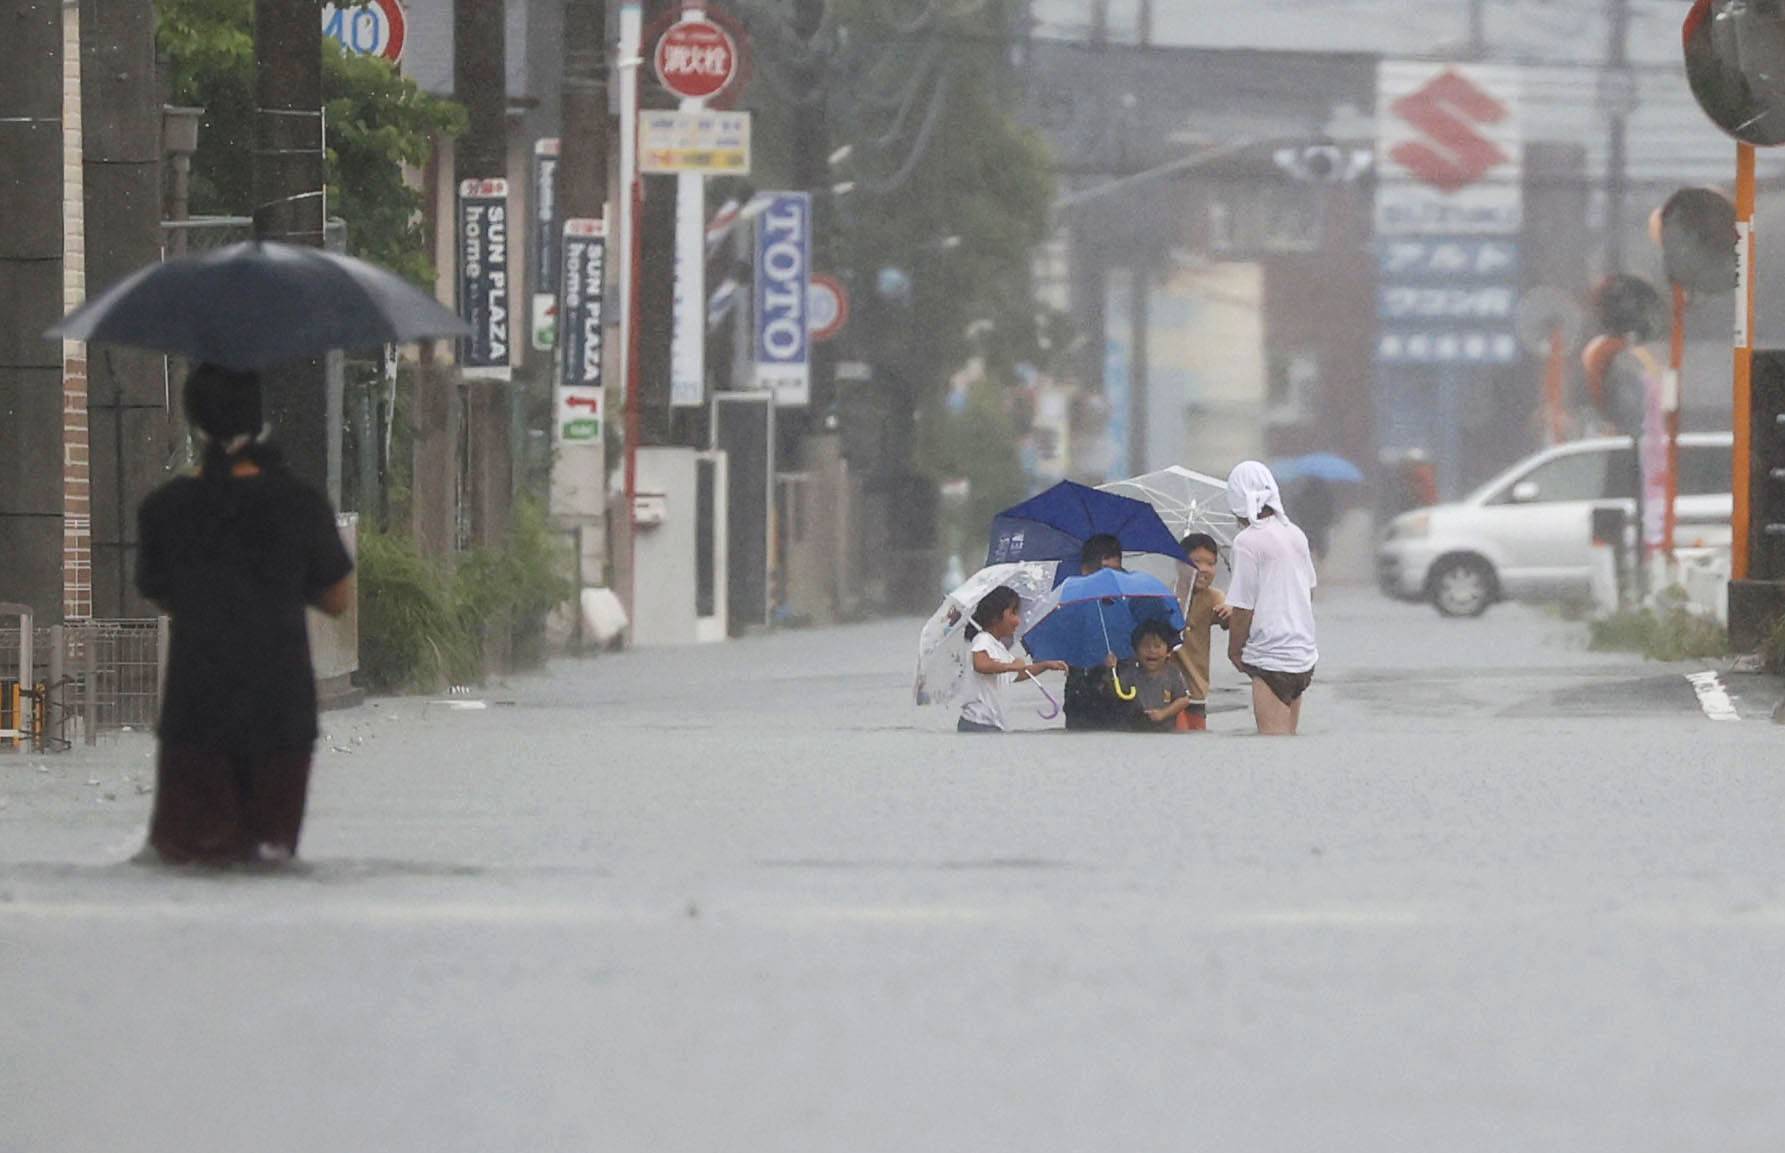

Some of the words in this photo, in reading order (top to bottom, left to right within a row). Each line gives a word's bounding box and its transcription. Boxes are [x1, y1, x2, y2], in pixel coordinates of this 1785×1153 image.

[466, 205, 485, 279] home
[488, 206, 505, 263] SUN
[585, 243, 603, 295] SUN
[566, 242, 585, 308] home
[763, 204, 803, 359] TOTO
[488, 271, 506, 360] PLAZA
[584, 302, 602, 381] PLAZA
